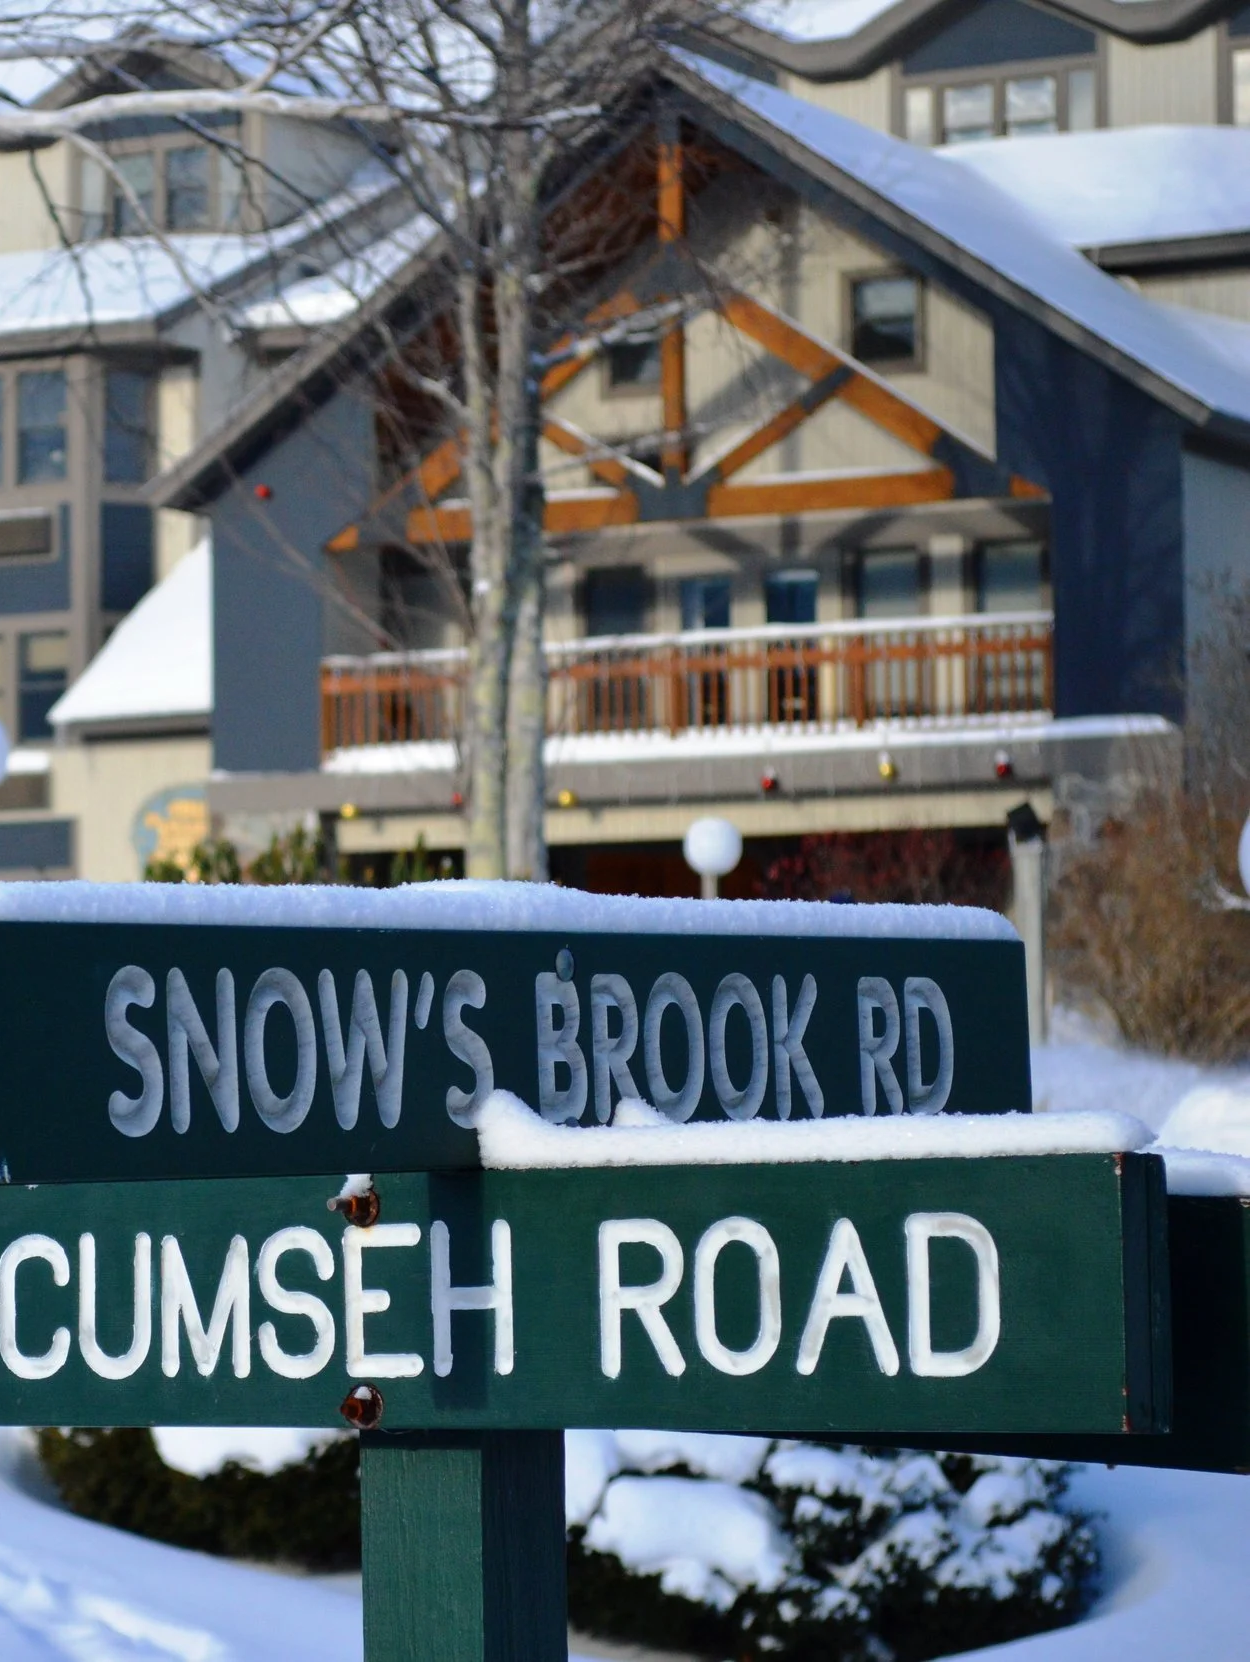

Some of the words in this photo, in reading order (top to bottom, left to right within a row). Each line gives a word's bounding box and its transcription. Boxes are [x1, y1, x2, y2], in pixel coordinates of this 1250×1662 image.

[104, 964, 494, 1138] SNOW'S
[535, 971, 825, 1124] BROOK
[857, 976, 954, 1117] RD
[598, 1211, 1001, 1379] ROAD
